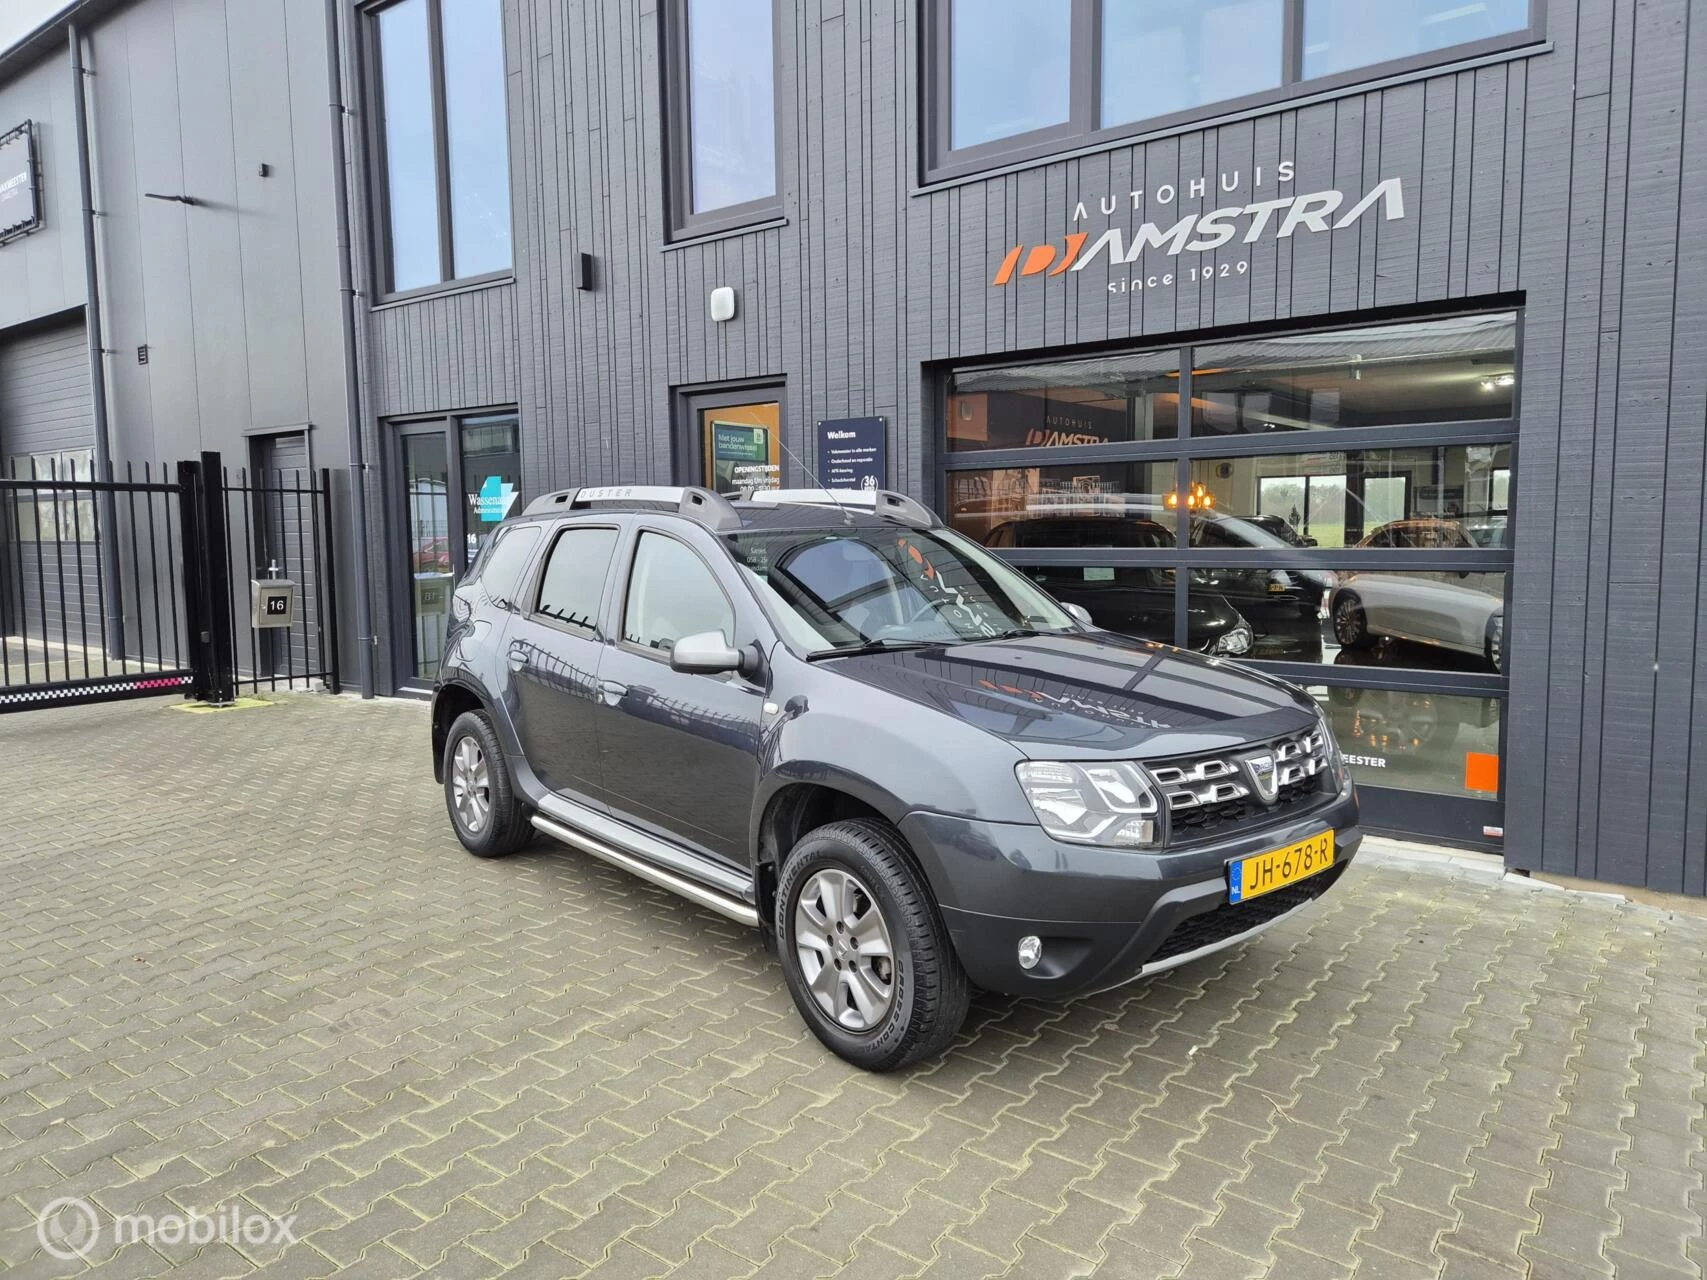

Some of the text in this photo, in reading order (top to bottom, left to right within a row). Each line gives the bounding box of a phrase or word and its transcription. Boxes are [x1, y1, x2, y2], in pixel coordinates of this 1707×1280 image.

[1073, 161, 1295, 222] AUTOHUIS
[1107, 261, 1249, 294] since 1929
[827, 430, 856, 440] Welkom
[864, 475, 876, 486] 36
[580, 488, 633, 499] DUSTER
[467, 533, 477, 544] 16
[270, 600, 284, 611] 16
[1342, 753, 1386, 768] EESTER
[1250, 838, 1328, 890] JH-678-R
[778, 850, 821, 940] CONTINENTAL
[1231, 886, 1240, 895] NL
